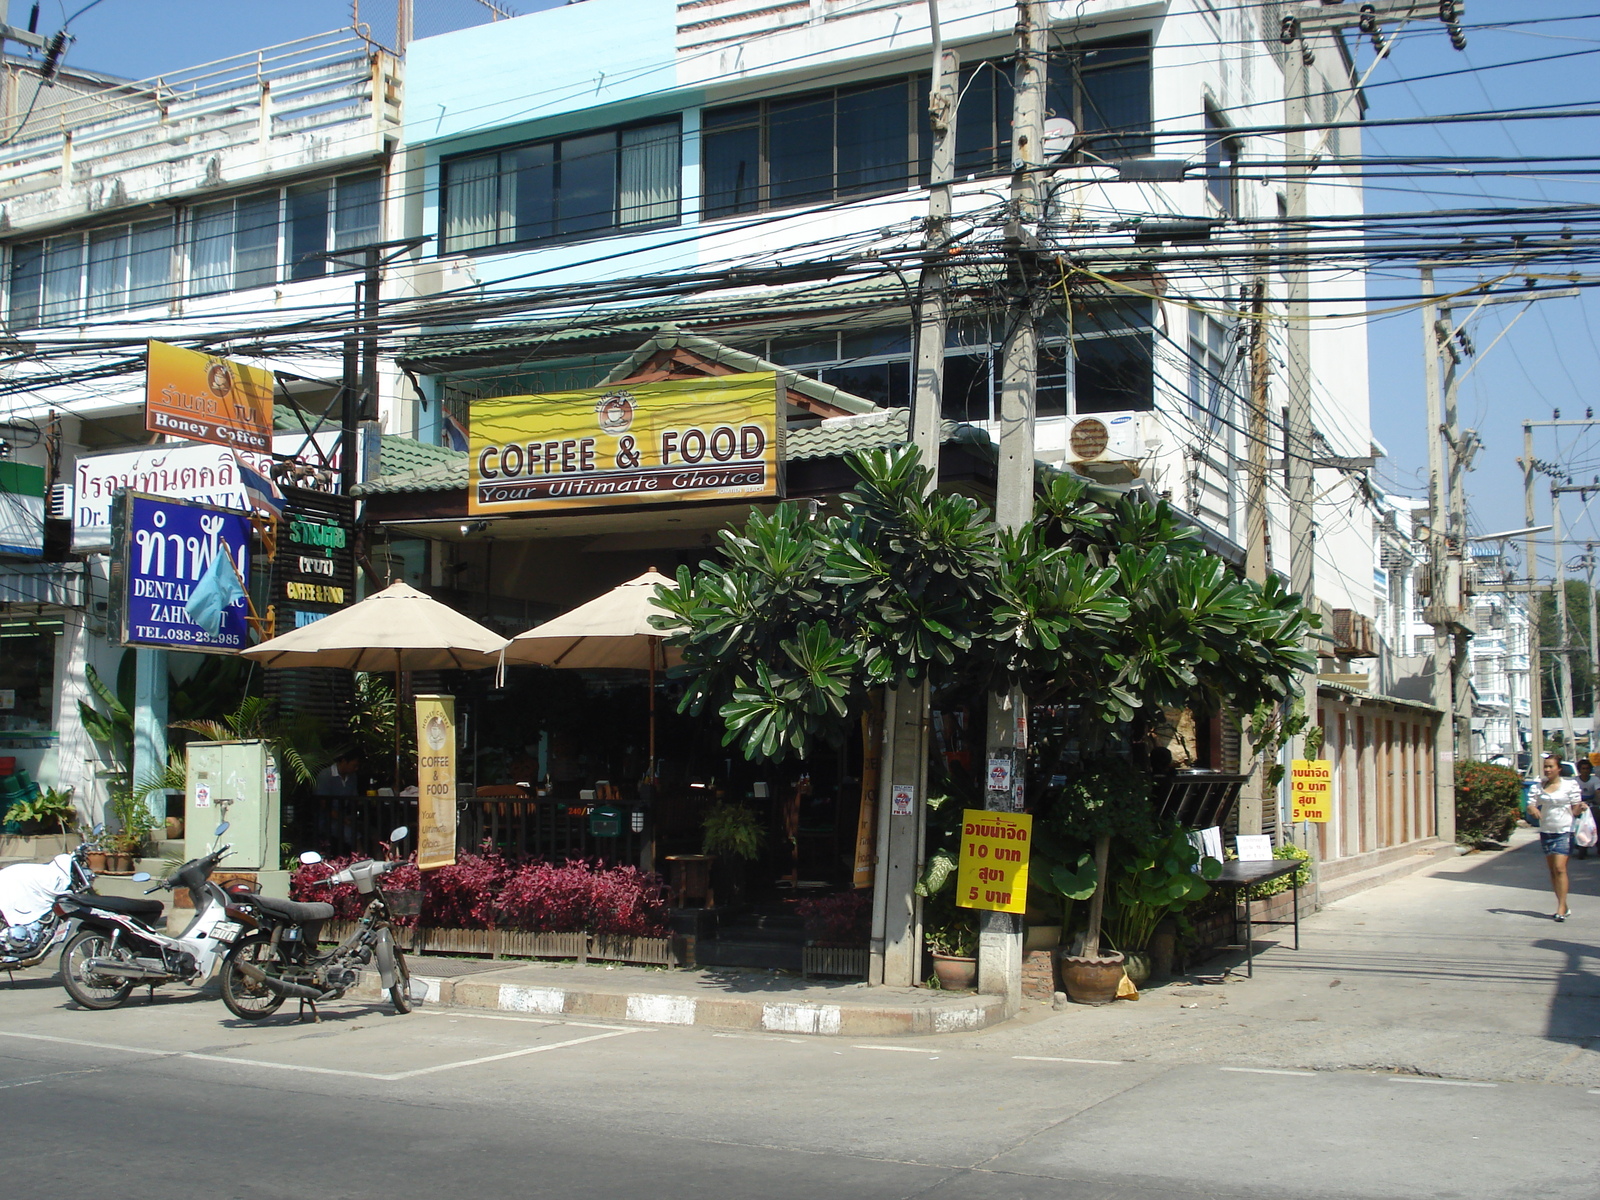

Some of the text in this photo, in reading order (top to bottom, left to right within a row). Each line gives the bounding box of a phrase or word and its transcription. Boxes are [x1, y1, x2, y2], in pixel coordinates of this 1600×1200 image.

[234, 404, 258, 425] TUI
[155, 412, 266, 447] Honey Coffee
[479, 425, 766, 480] COFFEE & FOOD
[482, 470, 761, 502] Your Ultimate Choice
[133, 578, 191, 603] DENTAL
[150, 603, 229, 628] ZAHNT
[421, 756, 450, 768] COFFEE
[432, 770, 439, 782] &
[426, 783, 449, 796] FOOD
[1291, 781, 1327, 792] 10 บาท
[1298, 795, 1317, 807] สุขา
[421, 810, 437, 820] Your
[1293, 808, 1323, 818] 5 บาท
[969, 843, 1022, 862] 10 บาท
[978, 866, 1005, 885] สุขา
[968, 886, 1012, 905] 5 บาท
